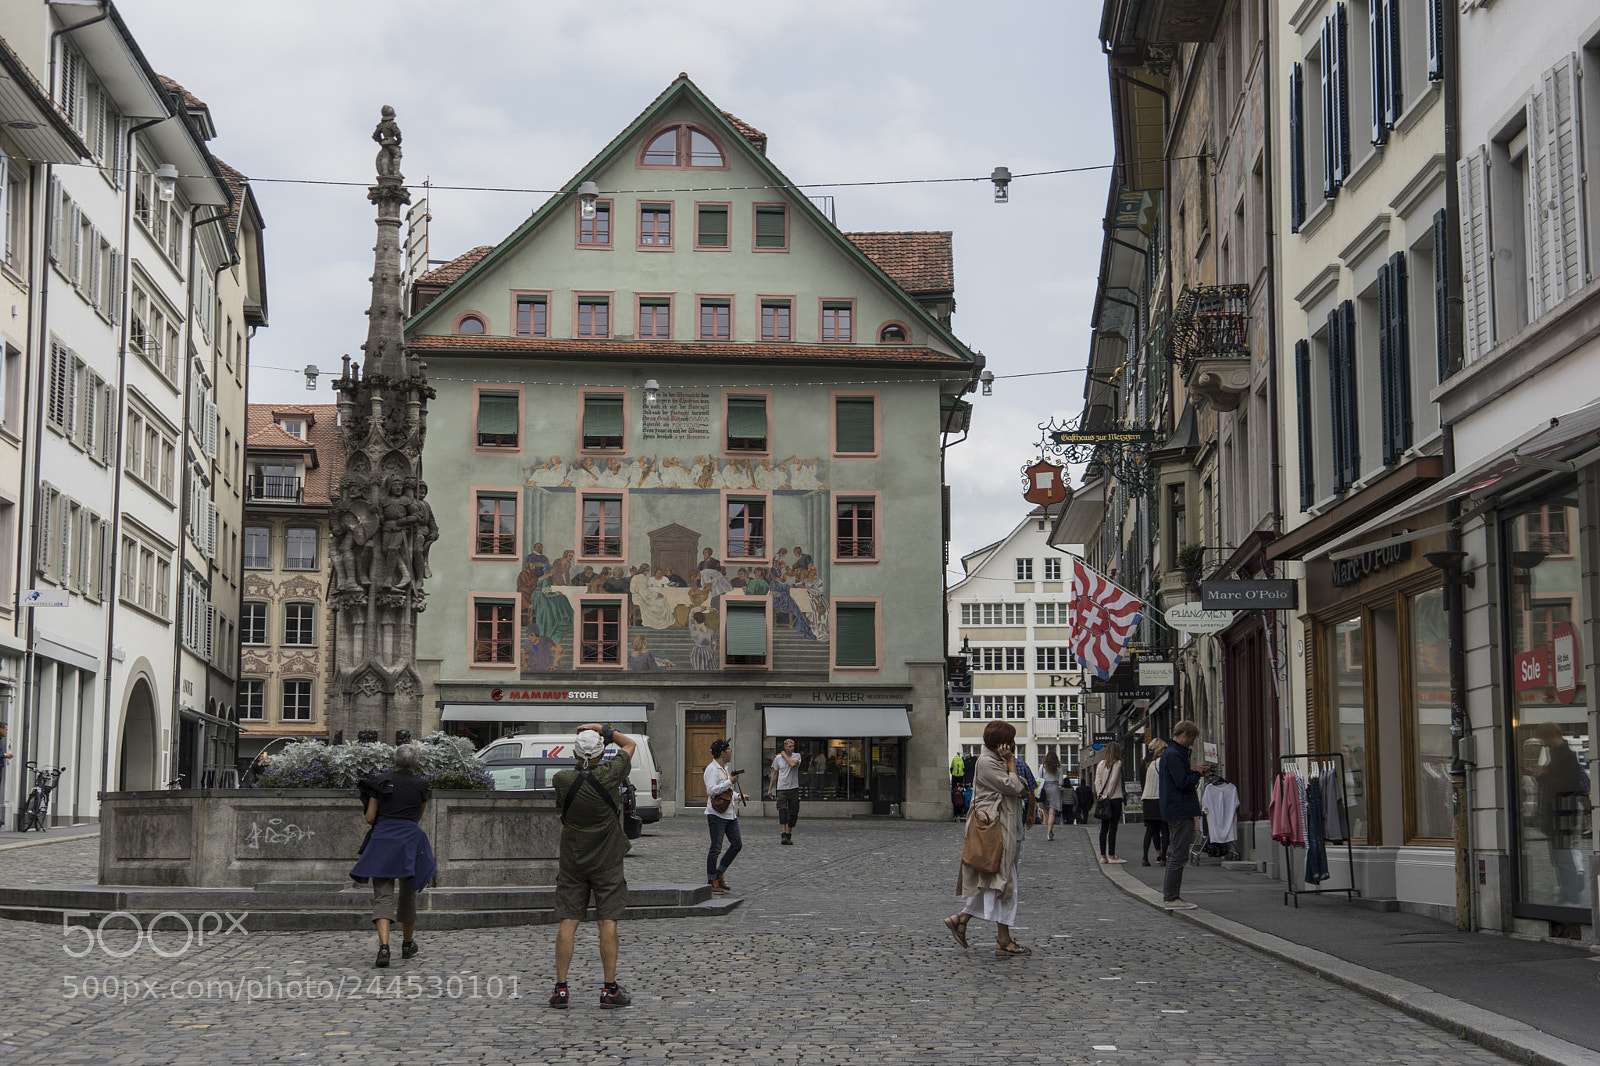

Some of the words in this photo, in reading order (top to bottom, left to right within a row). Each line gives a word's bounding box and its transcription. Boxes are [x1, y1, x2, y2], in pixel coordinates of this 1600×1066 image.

[1208, 590, 1242, 600] Marc
[1245, 590, 1288, 600] O'Polo
[1521, 657, 1541, 682] Sale
[812, 692, 822, 701] H.
[825, 692, 865, 702] WEBER
